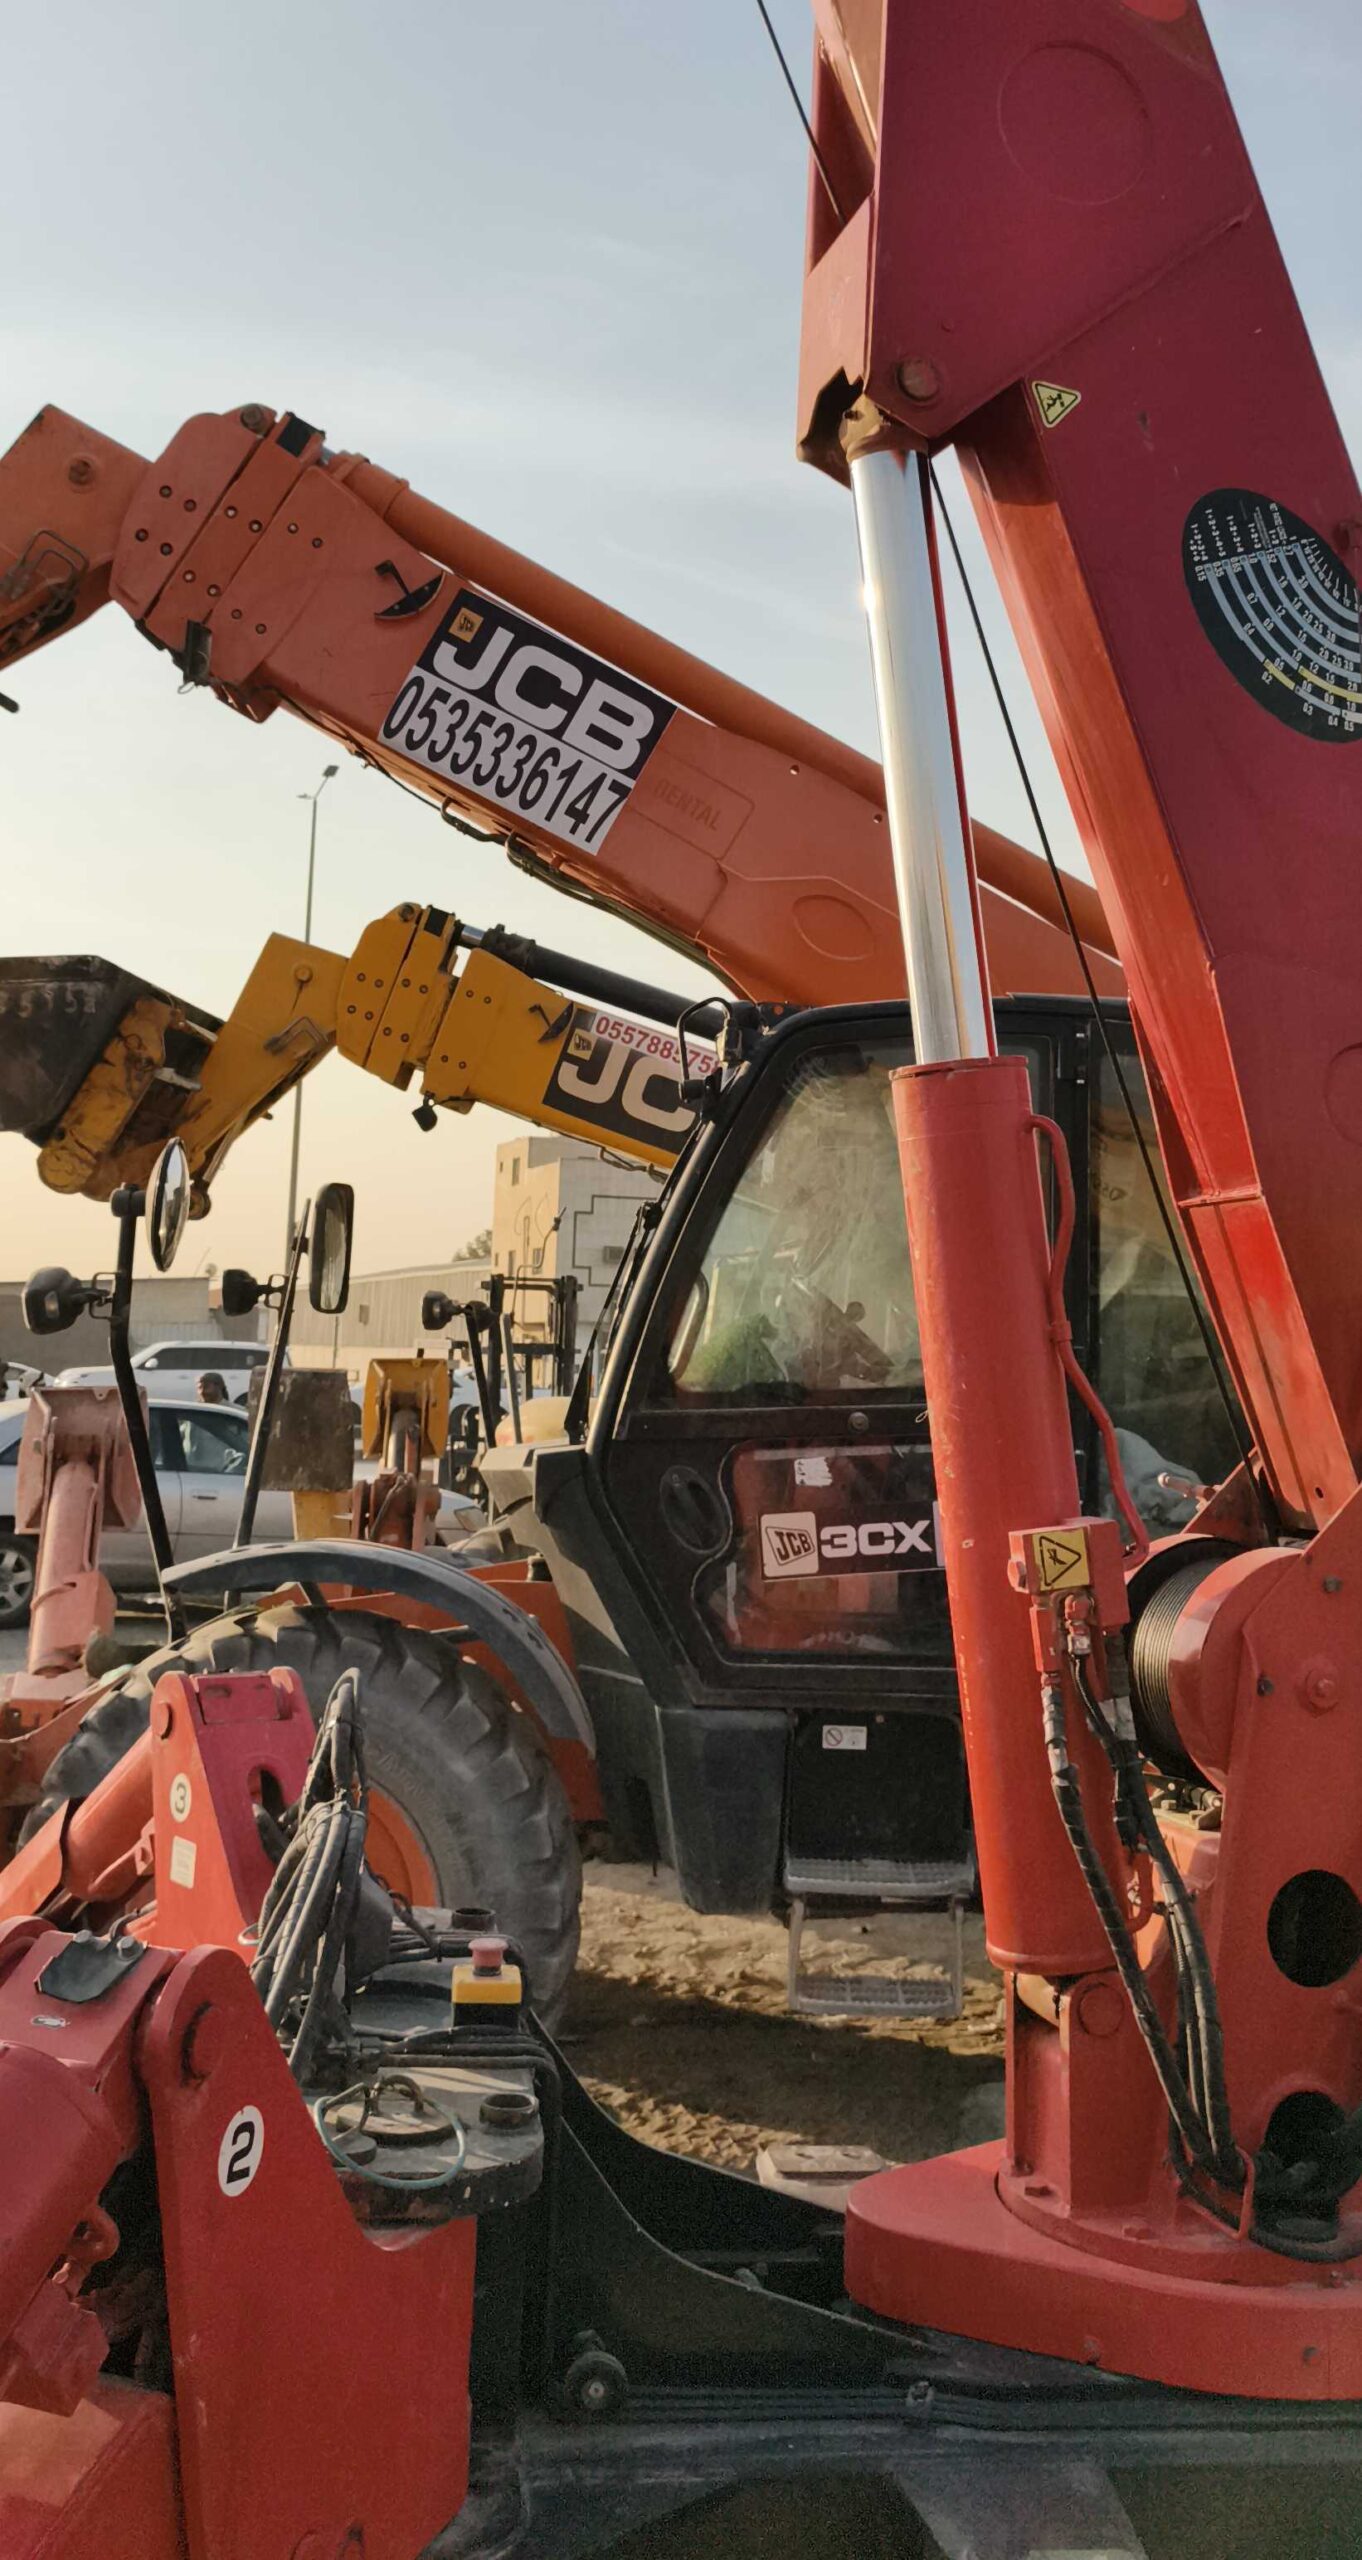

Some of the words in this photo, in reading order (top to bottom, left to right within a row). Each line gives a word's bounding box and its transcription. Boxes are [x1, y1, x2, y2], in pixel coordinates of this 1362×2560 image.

[433, 626, 654, 770] JCB
[382, 675, 632, 844] 0535336147
[774, 1531, 813, 1563] JCB
[820, 1520, 932, 1559] 3CX
[174, 1782, 187, 1815] 3
[226, 2120, 256, 2184] 2
